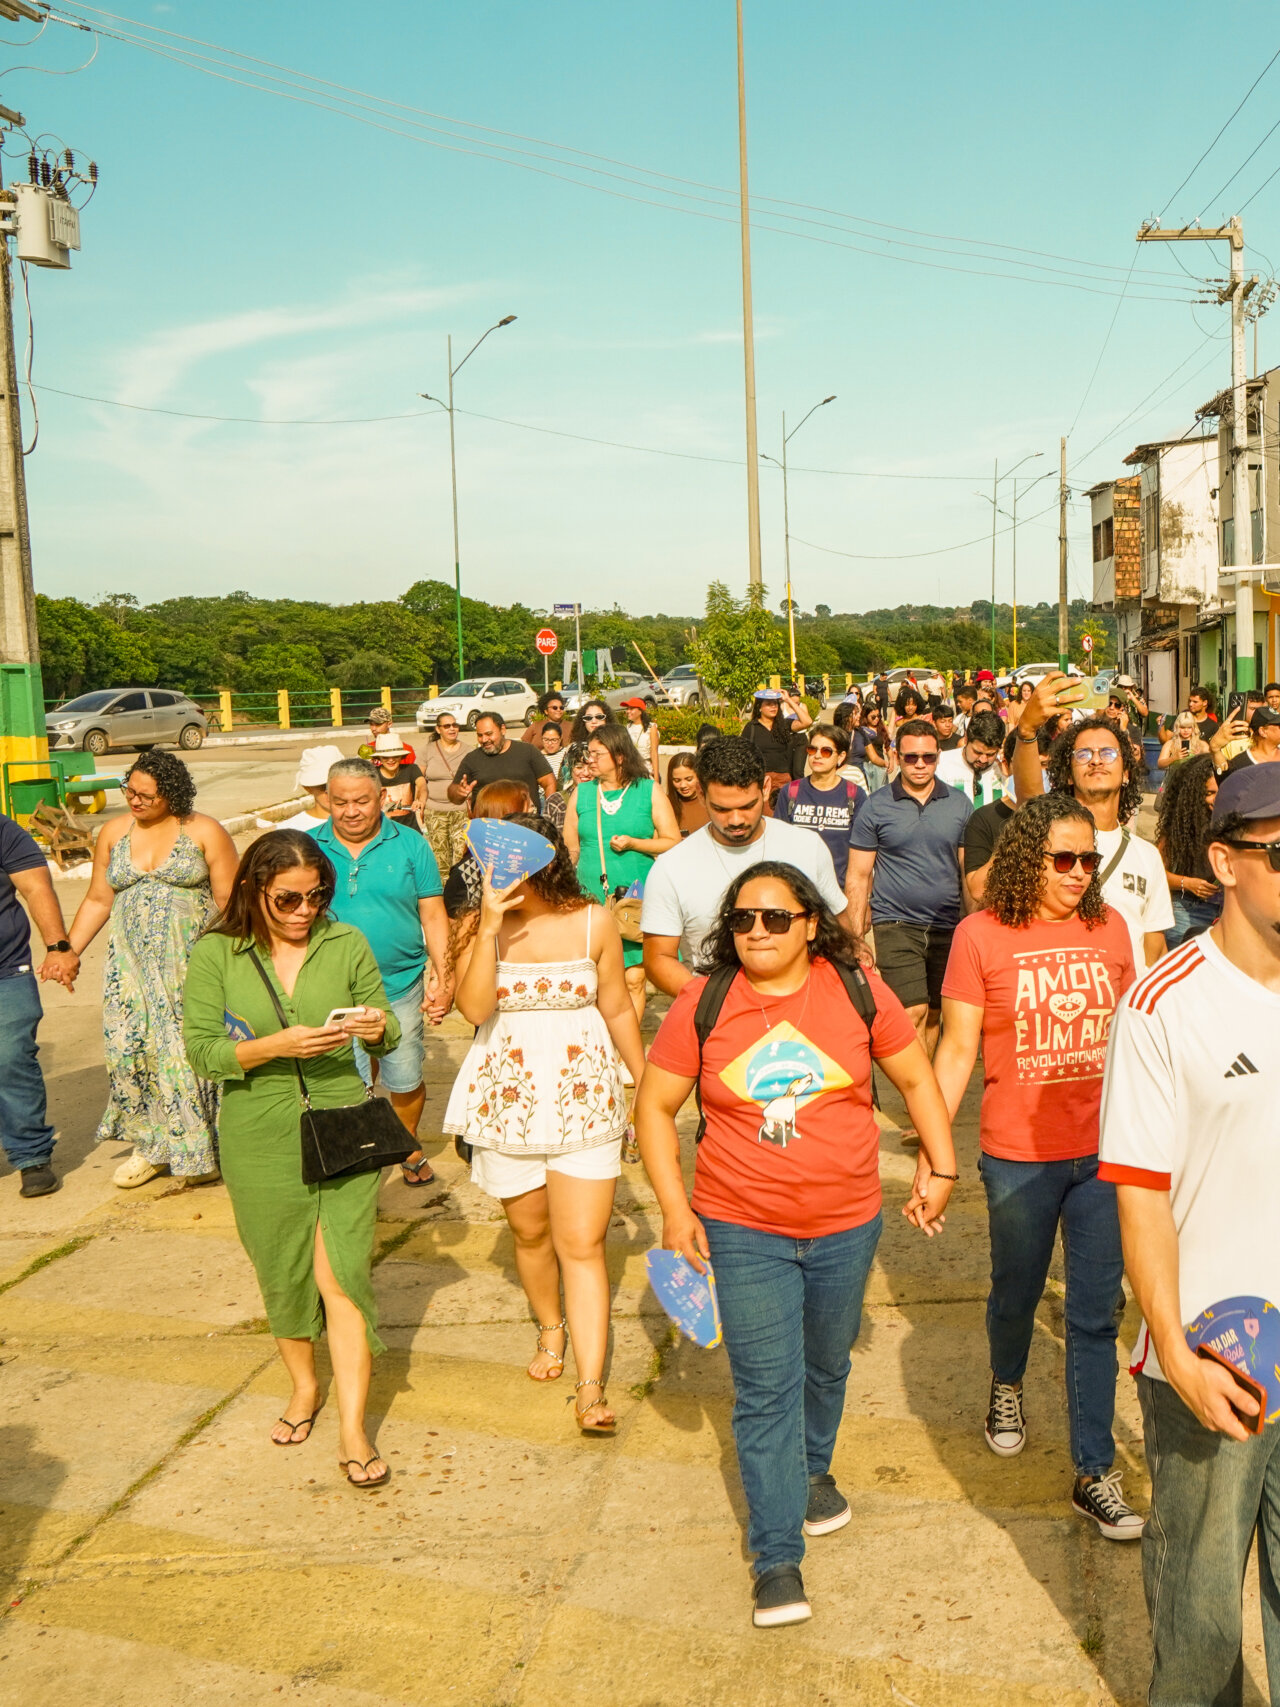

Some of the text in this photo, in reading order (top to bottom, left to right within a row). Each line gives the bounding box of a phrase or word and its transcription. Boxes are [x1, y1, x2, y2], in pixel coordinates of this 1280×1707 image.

[537, 637, 557, 647] PARE
[794, 804, 816, 816] AME
[816, 805, 824, 817] O
[812, 816, 818, 824] O
[1056, 952, 1066, 963] O
[1014, 962, 1116, 1012] AMOR
[1014, 1010, 1030, 1053] É
[1035, 1013, 1073, 1051] UM
[1016, 1046, 1107, 1071] REVOLUCIONARI
[1220, 1327, 1239, 1349] DAR
